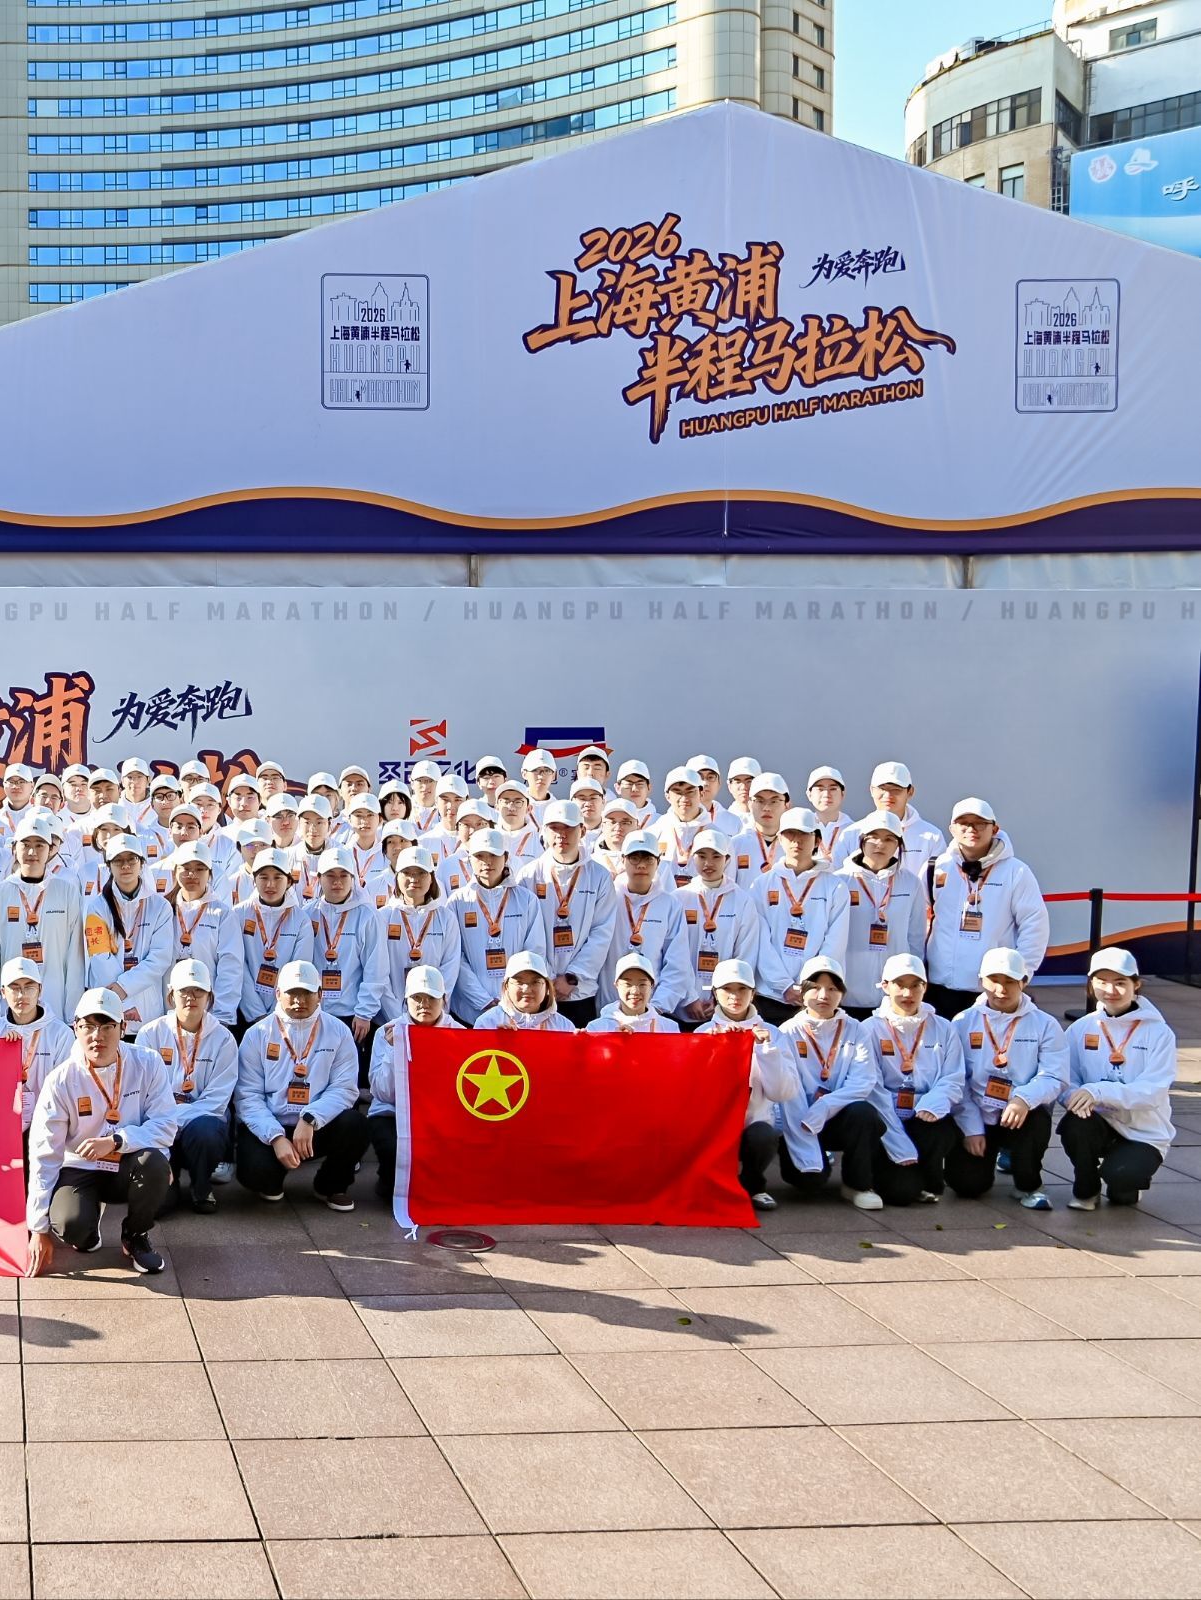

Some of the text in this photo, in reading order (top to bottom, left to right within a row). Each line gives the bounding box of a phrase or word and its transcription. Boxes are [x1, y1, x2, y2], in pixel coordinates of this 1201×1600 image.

[573, 212, 682, 272] 2026
[799, 245, 907, 290] 为爱奔跑
[360, 308, 386, 322] 2026
[522, 240, 785, 355] 上海黄浦
[330, 325, 420, 341] 上海黄浦半程马拉松
[1053, 312, 1077, 327] 2026
[329, 344, 420, 373] HUANGPU
[622, 306, 957, 444] 半程马拉松
[1023, 348, 1110, 376] HUANGPU
[680, 379, 925, 438] HUANGPU HALF MARATHON
[95, 601, 182, 621] HALF
[207, 601, 399, 621] MARATHON
[464, 600, 624, 621] HUANGPU
[648, 600, 732, 621] HALF
[755, 600, 939, 621] MARATHON
[1001, 600, 1156, 620] HUANGPU
[92, 679, 254, 744] 为爱奔跑
